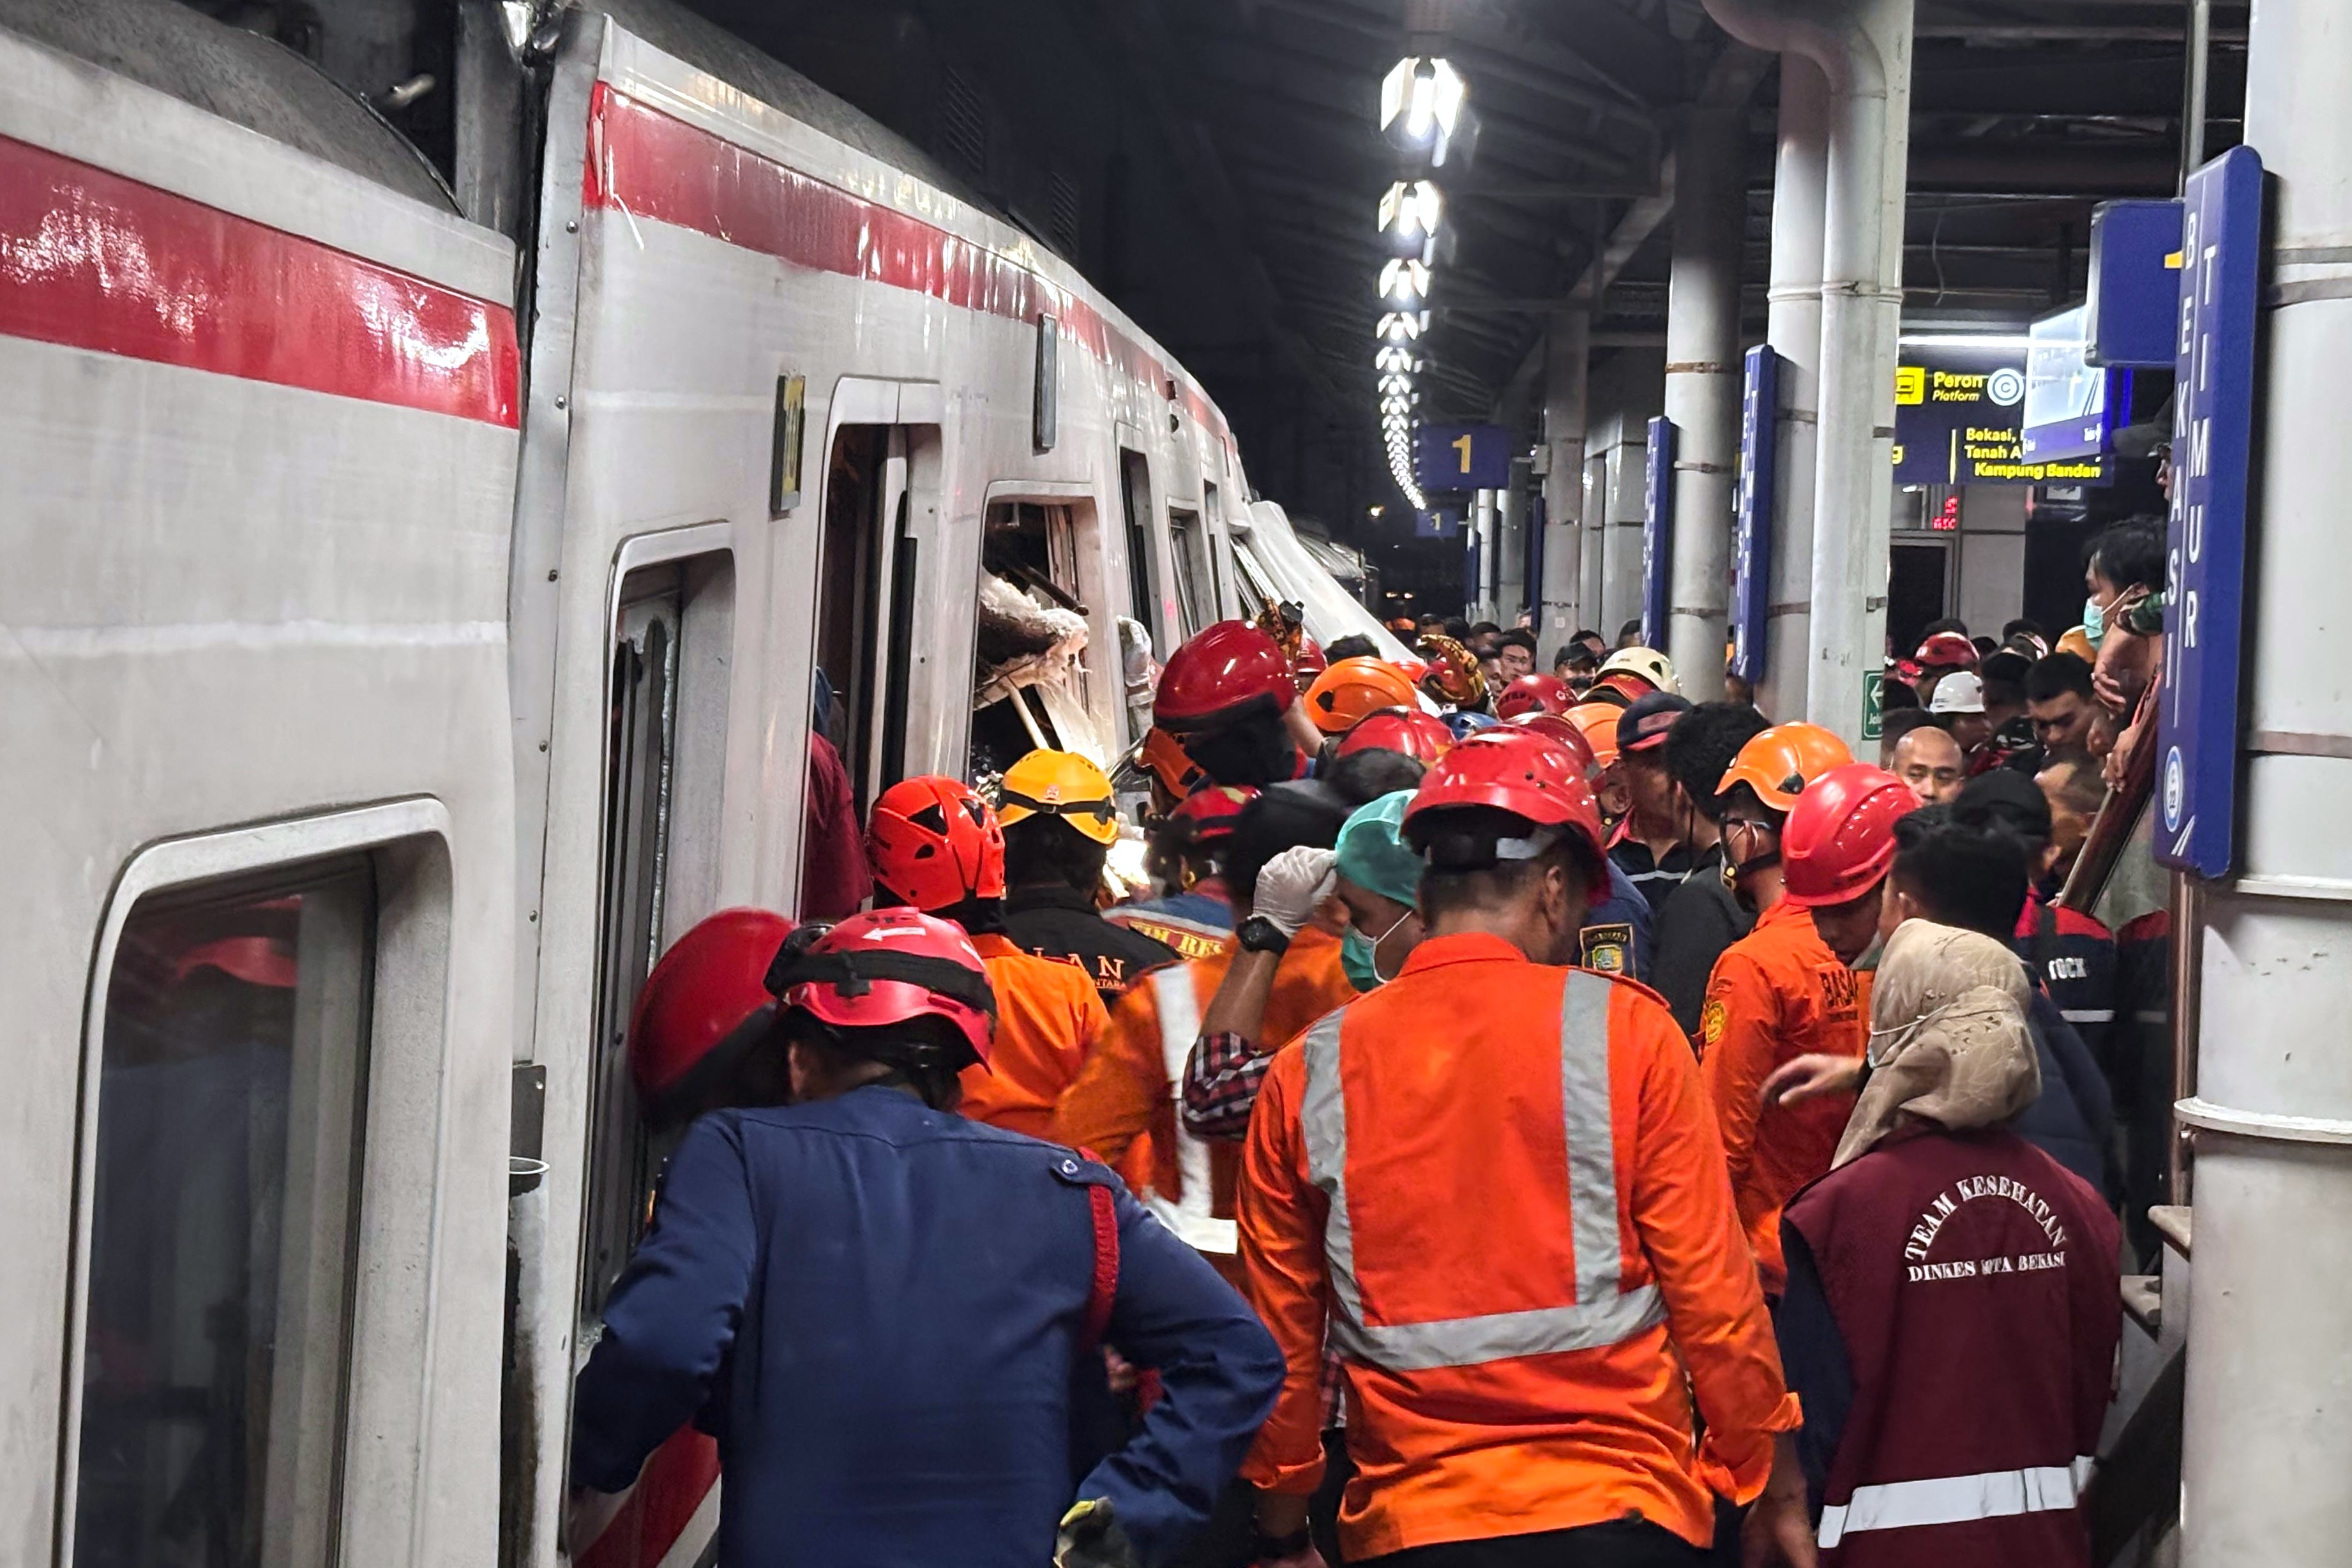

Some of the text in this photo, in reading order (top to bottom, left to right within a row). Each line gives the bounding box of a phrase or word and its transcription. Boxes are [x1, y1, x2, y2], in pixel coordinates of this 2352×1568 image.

[1934, 372, 1983, 388] Peron
[1932, 389, 1980, 402] Platform
[1966, 427, 2017, 444] Bekasi,
[1452, 434, 1472, 473] 1
[1964, 445, 2008, 459] Tanah
[2166, 213, 2196, 689] BEKASI
[2185, 244, 2217, 648] TIMUR
[1975, 462, 2101, 480] Kampung Bandan
[1431, 512, 1441, 531] 1
[1904, 1175, 2067, 1261] TEAM KESEHATAN
[1907, 1260, 1976, 1282] DINKES
[2018, 1251, 2066, 1271] BEKASI
